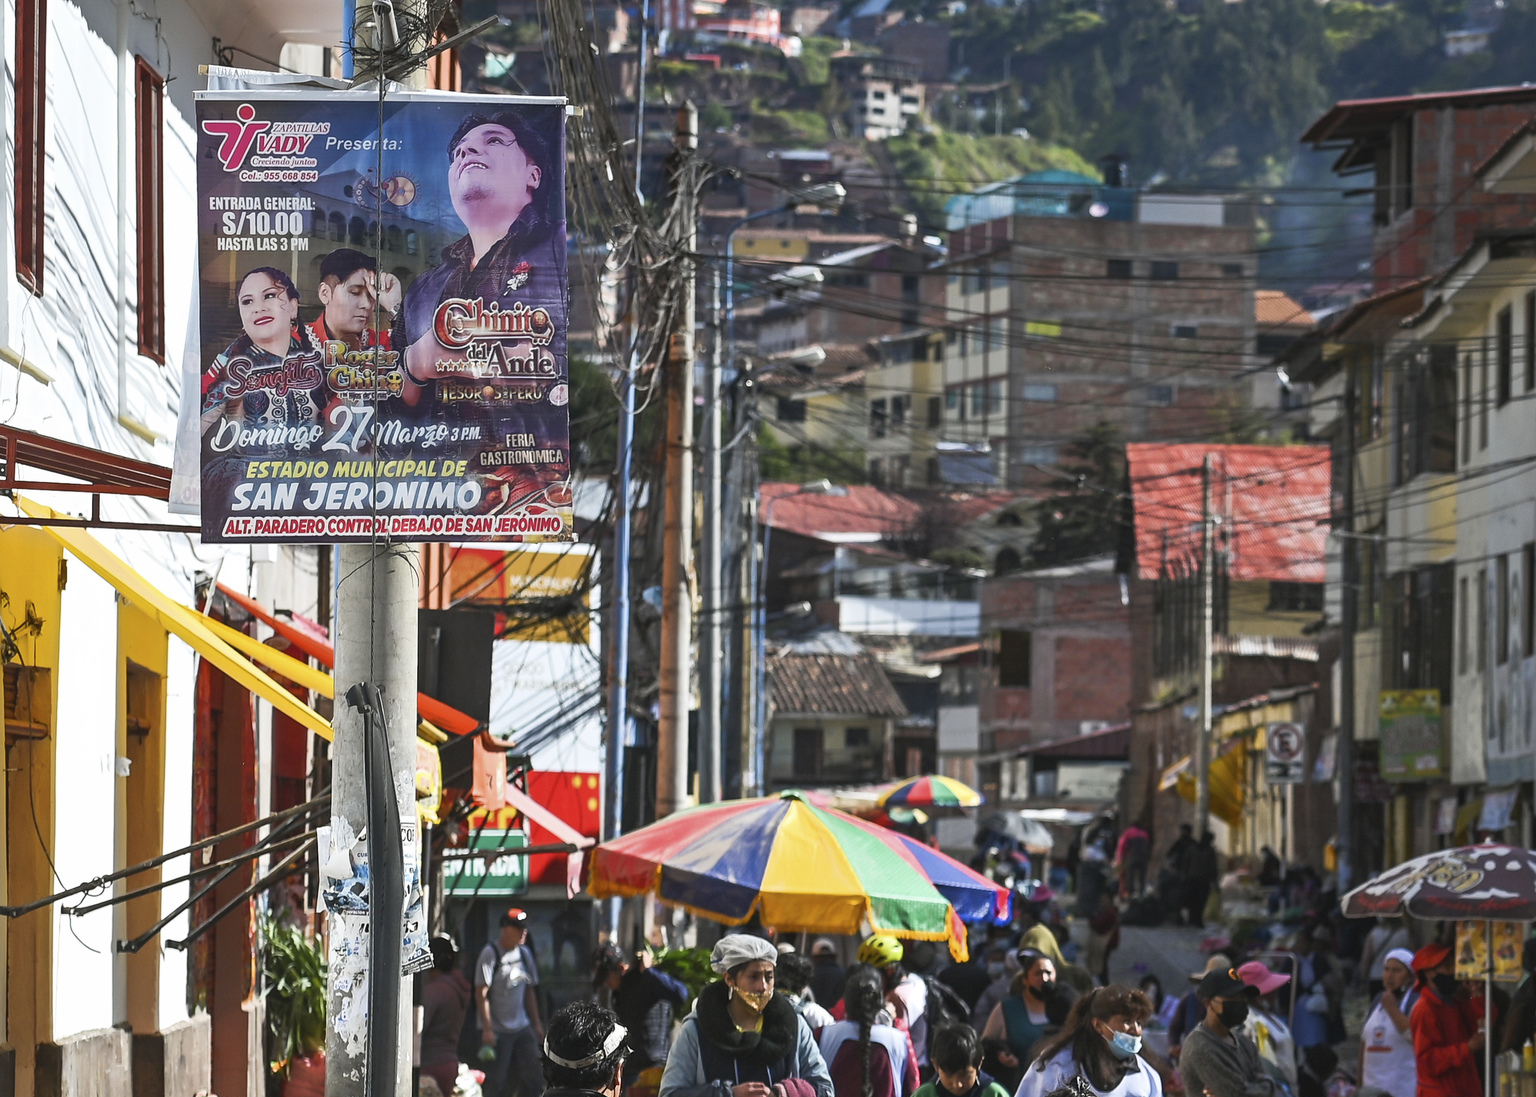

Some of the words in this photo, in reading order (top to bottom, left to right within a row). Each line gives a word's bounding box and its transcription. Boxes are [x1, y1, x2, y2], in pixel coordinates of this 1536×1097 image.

[272, 122, 330, 135] ZAPATILLAS
[257, 134, 313, 154] VADY
[325, 136, 403, 151] Presenta:
[252, 157, 290, 167] Creciendo
[291, 158, 316, 168] juntos
[263, 172, 281, 181] 955
[282, 172, 300, 181] 668
[301, 172, 317, 181] 854
[209, 197, 263, 211] ENTRADA
[264, 197, 316, 211] GENERAL:
[222, 211, 304, 236] S/10.00
[217, 237, 254, 251] HASTA
[256, 237, 278, 251] LAS
[280, 238, 288, 251] 3
[290, 237, 309, 251] PM
[323, 340, 399, 370] Roger
[468, 342, 488, 360] del
[485, 341, 556, 378] Ande
[210, 417, 323, 452] Domingo
[321, 405, 375, 454] 27
[371, 419, 448, 448] Marzo
[450, 428, 458, 441] 3
[461, 426, 482, 441] P.M.
[506, 433, 535, 448] FERIA
[480, 449, 563, 466] GASTRONÓMICA
[246, 461, 329, 479] ESTADIO
[332, 460, 438, 479] MUNICIPAL
[441, 460, 468, 477] DE
[231, 482, 300, 511] SAN
[303, 481, 482, 511] JERONIMO
[225, 519, 251, 535] ALT.
[254, 519, 326, 534] PARADERO
[327, 519, 388, 534] CONTROL
[392, 518, 443, 533] DEBAJO
[445, 518, 463, 532] DE
[466, 517, 493, 532] SAN
[495, 514, 561, 532] JERÓNIMO
